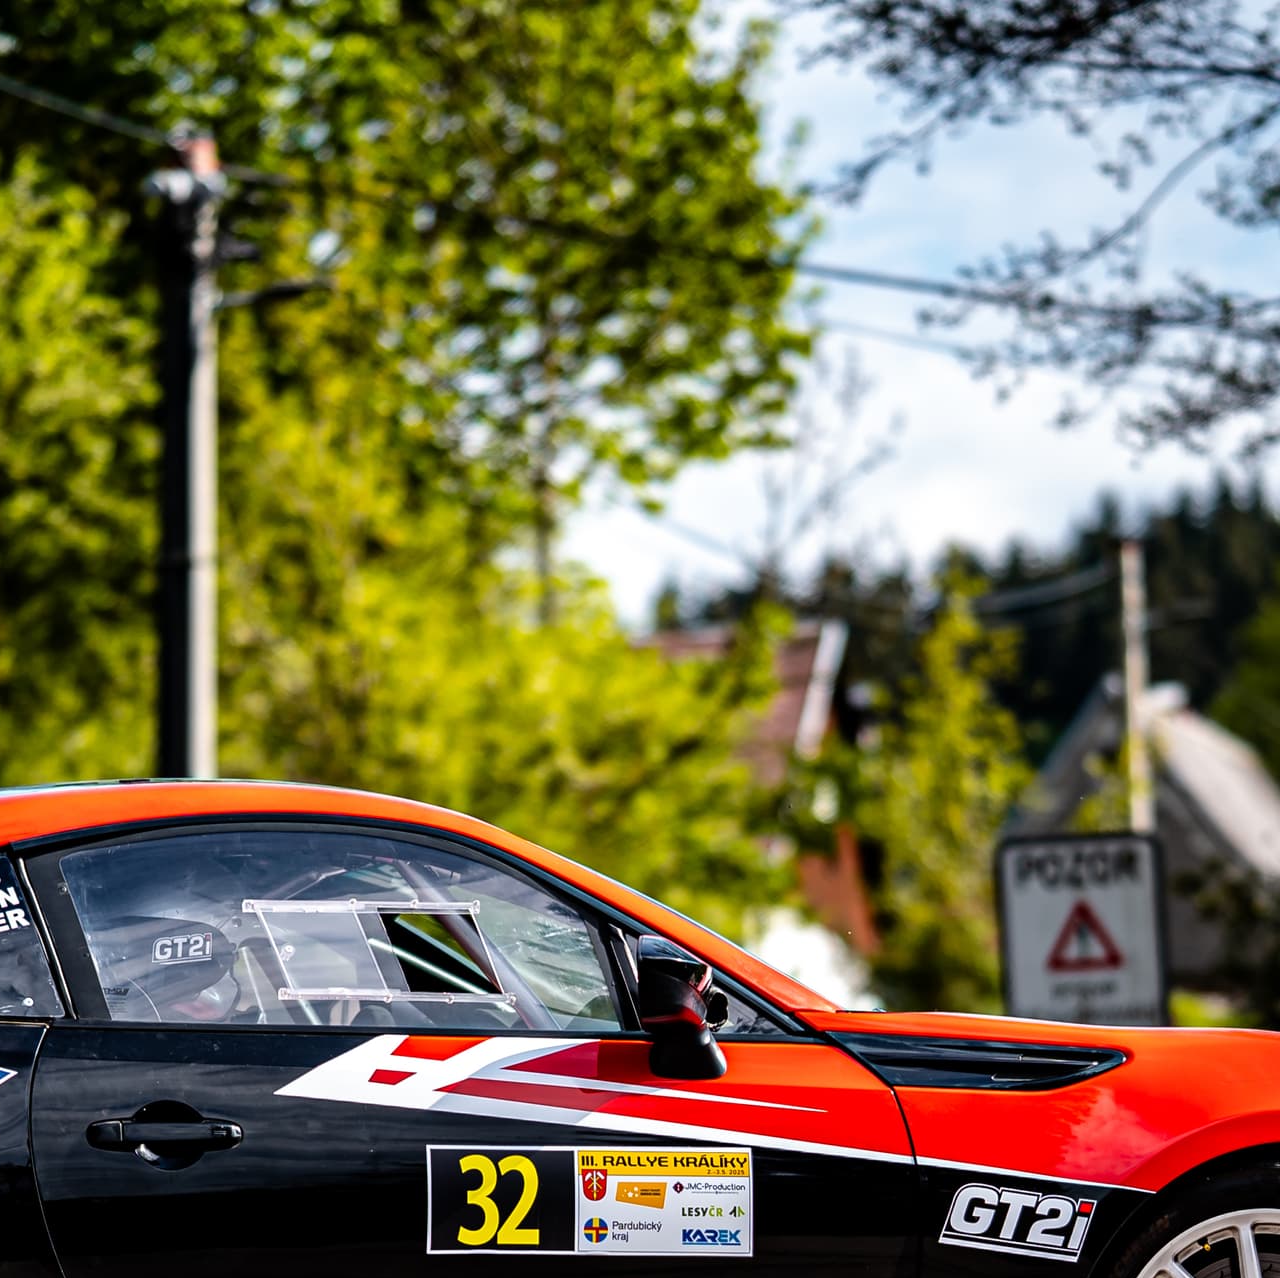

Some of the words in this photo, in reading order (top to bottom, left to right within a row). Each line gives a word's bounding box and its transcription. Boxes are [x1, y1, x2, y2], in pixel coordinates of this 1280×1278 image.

[1016, 851, 1140, 892] POZOR
[154, 933, 212, 960] GT2i
[581, 1155, 598, 1167] III.
[602, 1155, 669, 1168] RALLYE
[674, 1153, 748, 1168] KRÁLÍKY
[685, 1182, 746, 1191] JMC-Production
[457, 1153, 540, 1246] 32
[949, 1185, 1095, 1250] GT2i
[612, 1220, 662, 1232] Pardubický
[612, 1231, 629, 1243] kraj
[682, 1229, 741, 1243] KAREX
